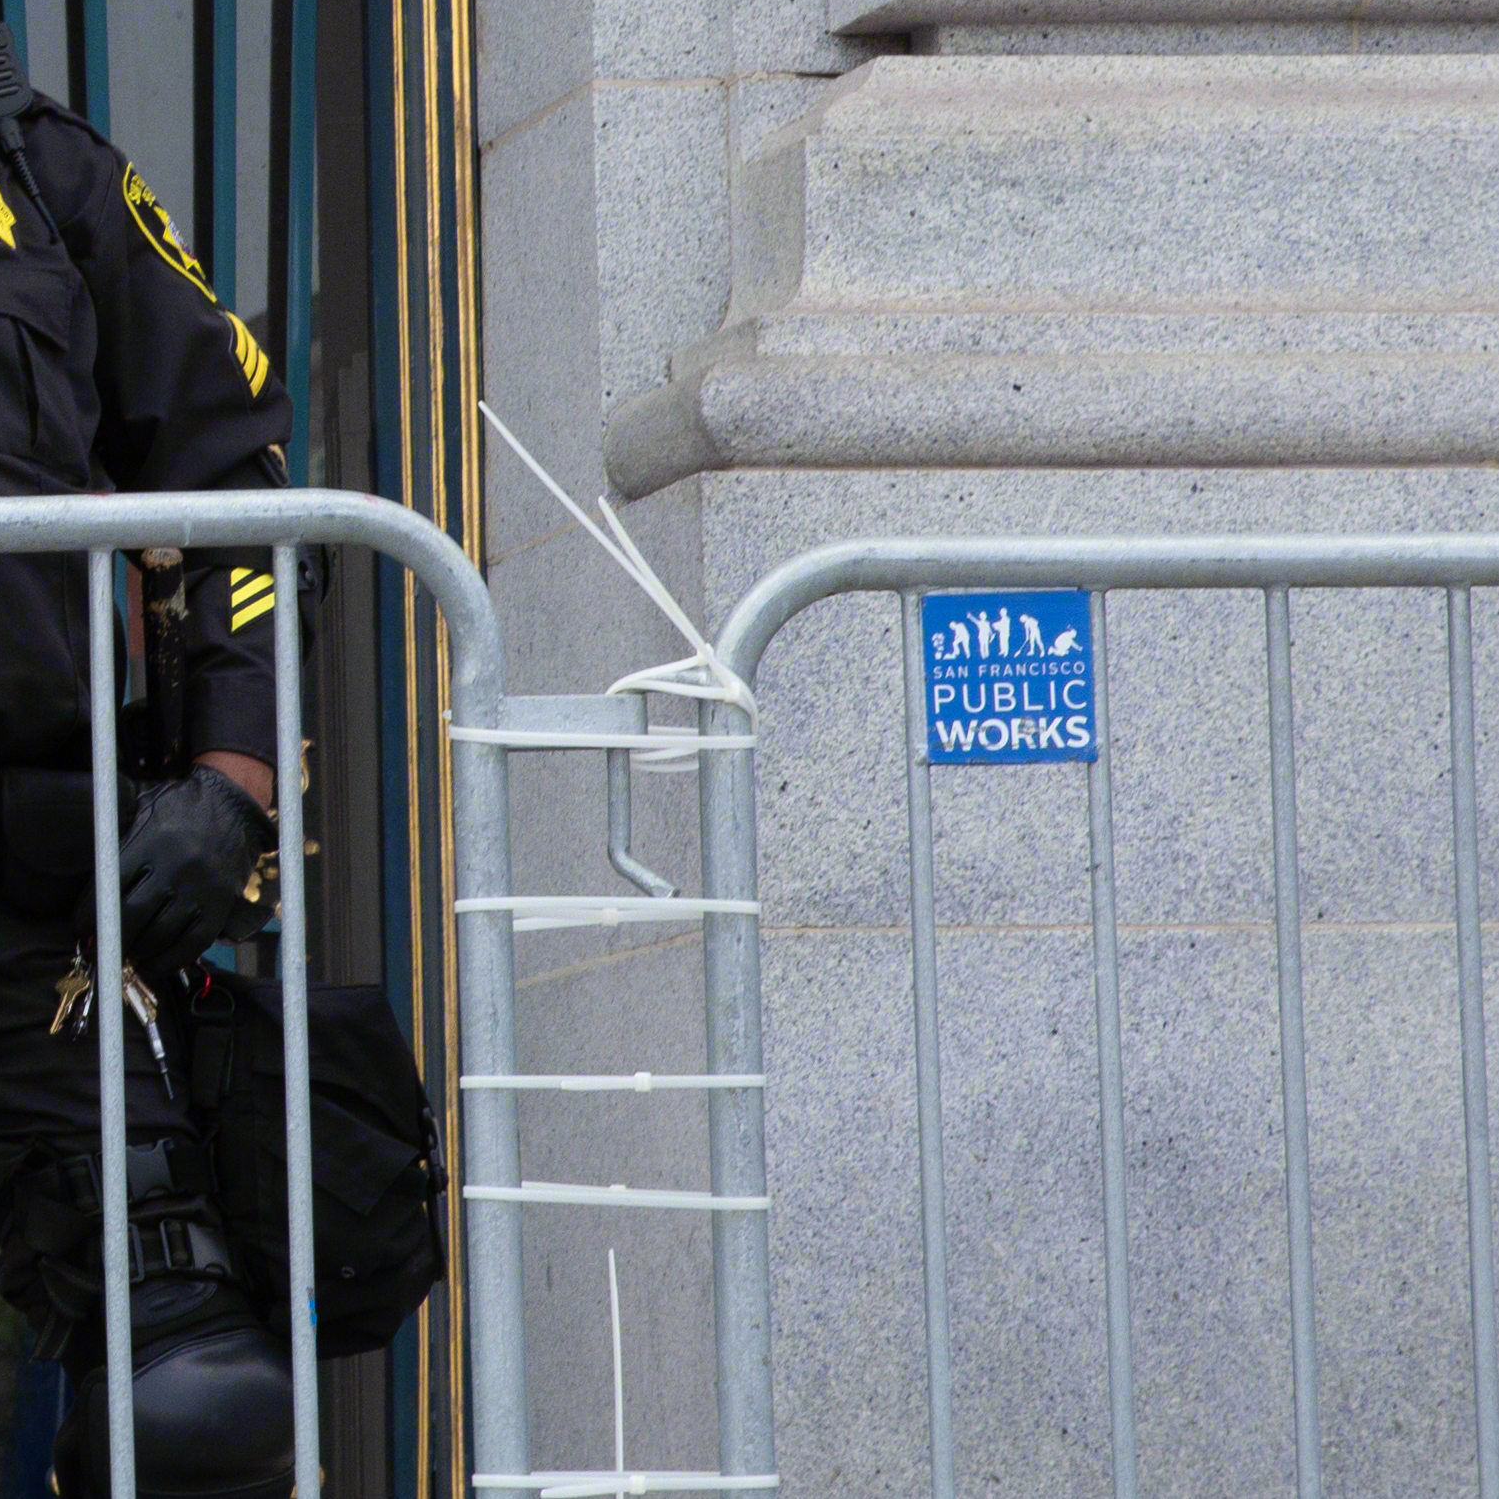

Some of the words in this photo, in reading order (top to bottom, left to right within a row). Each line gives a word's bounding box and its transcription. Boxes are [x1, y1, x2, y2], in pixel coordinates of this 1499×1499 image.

[933, 665, 969, 680] SAN
[979, 661, 1085, 678] FRANCISCO
[933, 679, 1087, 714] PUBLIC
[935, 715, 1091, 752] WORKS
